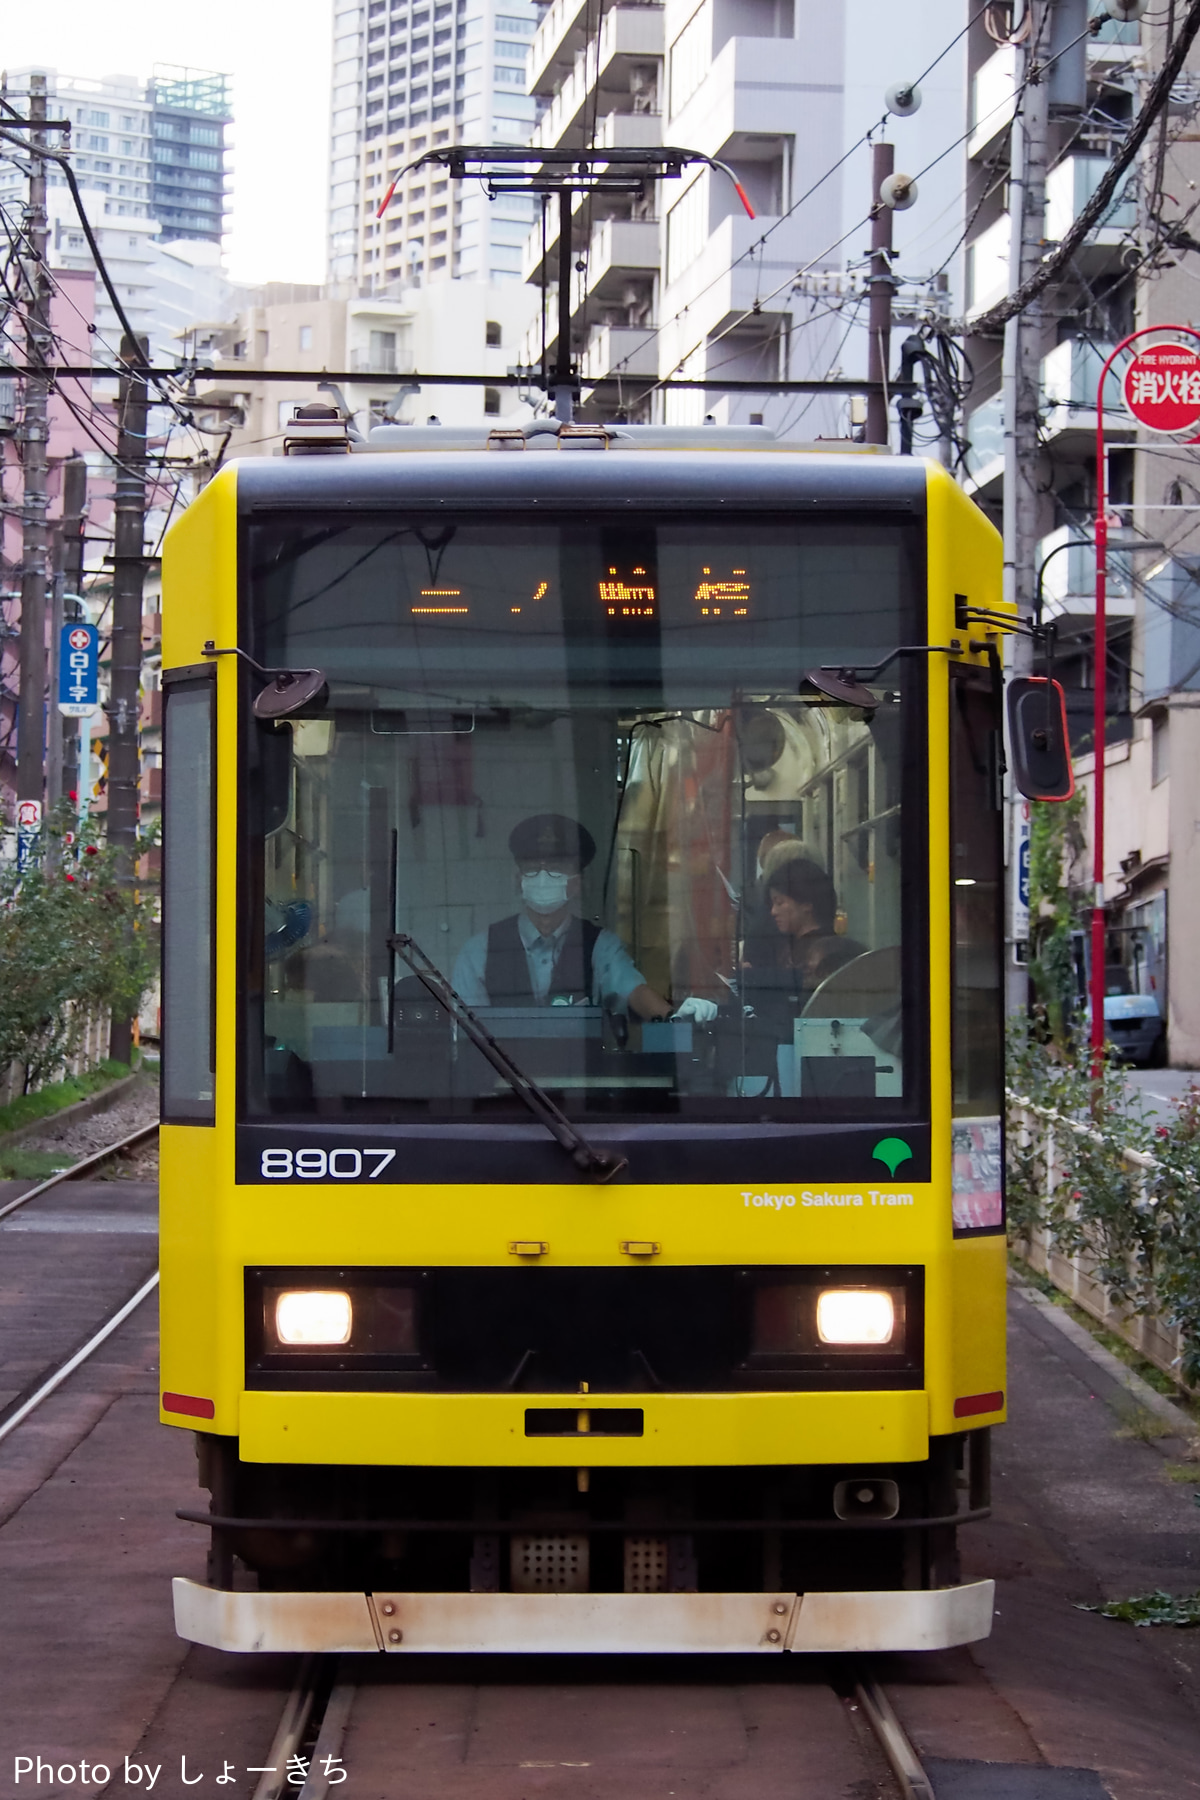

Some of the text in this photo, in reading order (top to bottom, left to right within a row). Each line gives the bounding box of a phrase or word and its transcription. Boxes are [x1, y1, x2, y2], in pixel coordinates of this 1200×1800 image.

[1138, 355, 1197, 365] FIRE HYDRANT
[1131, 370, 1200, 405] 消火栓
[69, 651, 89, 702] 白十字
[261, 1148, 397, 1179] 8907
[740, 1190, 914, 1210] Tokyo Sakura Tram
